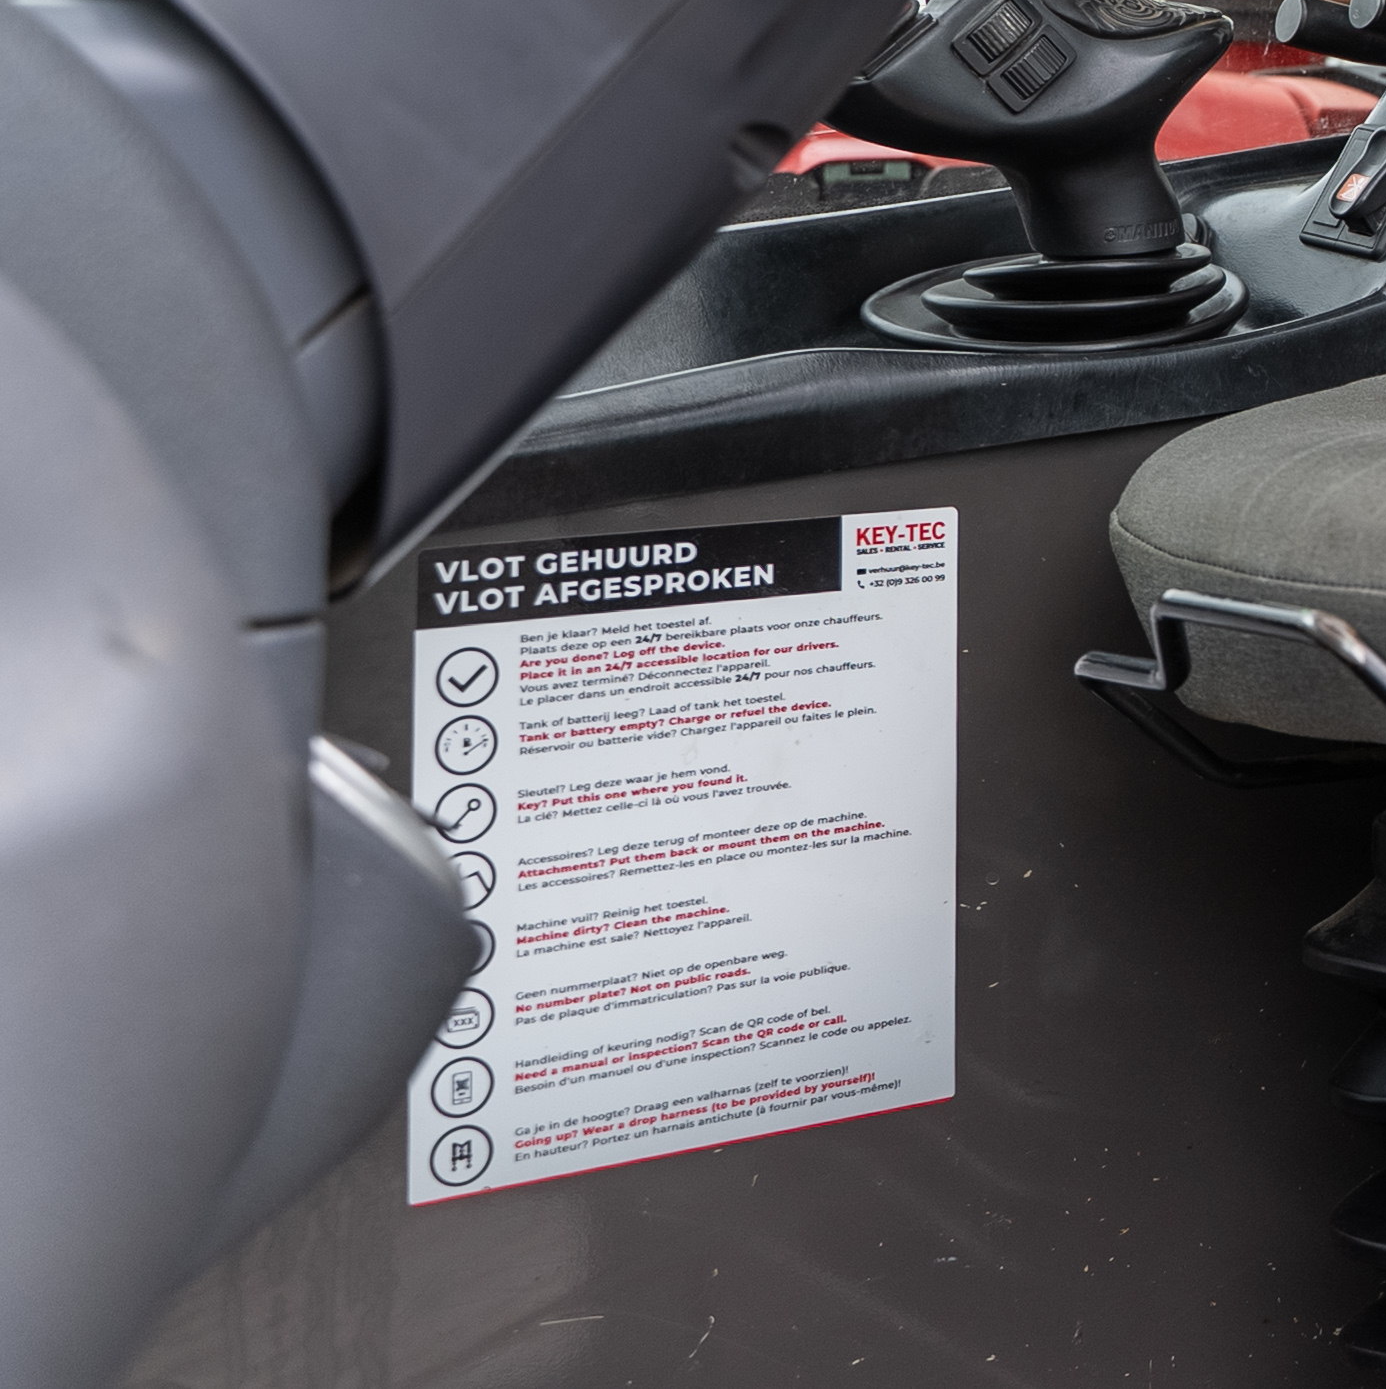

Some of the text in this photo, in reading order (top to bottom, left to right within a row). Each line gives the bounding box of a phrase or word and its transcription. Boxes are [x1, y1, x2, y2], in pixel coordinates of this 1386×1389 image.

[856, 521, 946, 546] KEY-TEC
[856, 542, 946, 555] SALES RENTAL SERVICE
[435, 542, 698, 584] VLOT GEHUURD
[869, 574, 946, 588] +32 (0)9 326 00 99
[434, 563, 775, 615] VLOT AFGESPROKEN
[520, 616, 711, 643] Ben je klaar? Meld het toestel af.
[520, 613, 883, 655] Plaats deze op een 24/7 bereikbare plaats voor onze chauffeurs.
[519, 640, 725, 668] Are you done? Log off the device.
[519, 641, 839, 681] Place it in an 24/7 accessible location for our drivers.
[519, 658, 770, 693] Vous avez terminé? Déconnectez l'appareil.
[518, 700, 831, 742] Tank or battery empty? Charge or refuel the device.
[519, 692, 785, 730] Tank of batterij leeg? Laad of tank het toestel.
[517, 763, 730, 798] Sleutel? Leg deze waar je hem vond.
[517, 773, 748, 811] Key? Put this one where you found it.
[517, 820, 885, 879] Attachments? Put them back or mount them on the machine.
[516, 895, 707, 932] Machine vuil? Reinig het toestel.
[516, 906, 730, 945] Machine dirty? Clean the machine.
[515, 950, 787, 1000] Geen nummerplaat? Niet op de openbare weg.
[515, 967, 751, 1013] No number plate? Not on public roads.
[514, 1014, 847, 1081] Need a manual or inspection? Scan the QR code or call.
[514, 1135, 552, 1149] Going
[555, 1129, 578, 1141] up?
[582, 1123, 614, 1136] Wear
[628, 1115, 657, 1127] drop
[660, 1105, 708, 1121] harness
[711, 1102, 728, 1113] (to
[730, 1098, 746, 1107] be
[748, 1085, 801, 1106] provided
[803, 1084, 818, 1094] by
[820, 1071, 875, 1092] yourself)!
